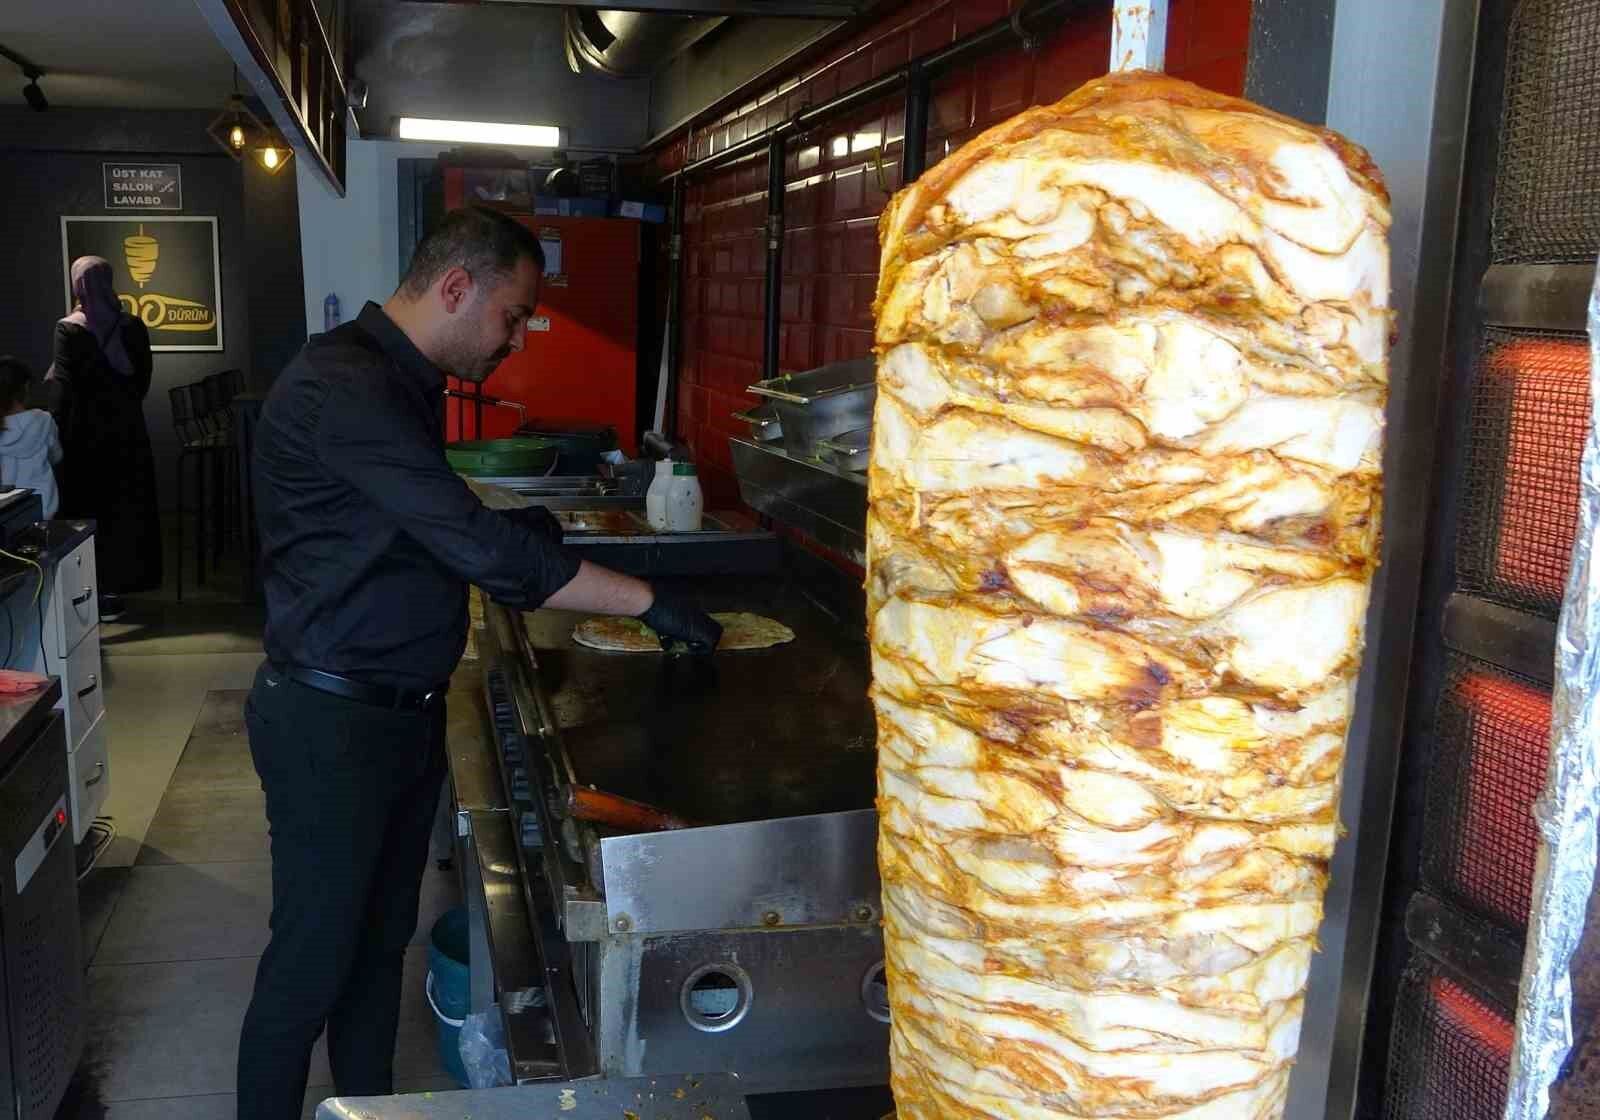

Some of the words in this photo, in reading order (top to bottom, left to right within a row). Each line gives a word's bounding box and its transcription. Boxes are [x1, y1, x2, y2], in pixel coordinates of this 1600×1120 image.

[113, 168, 136, 178] ÜST
[140, 170, 164, 178] KAT
[113, 183, 153, 192] SALON
[114, 196, 161, 205] LAVABO
[168, 308, 209, 321] DÜRÜM
